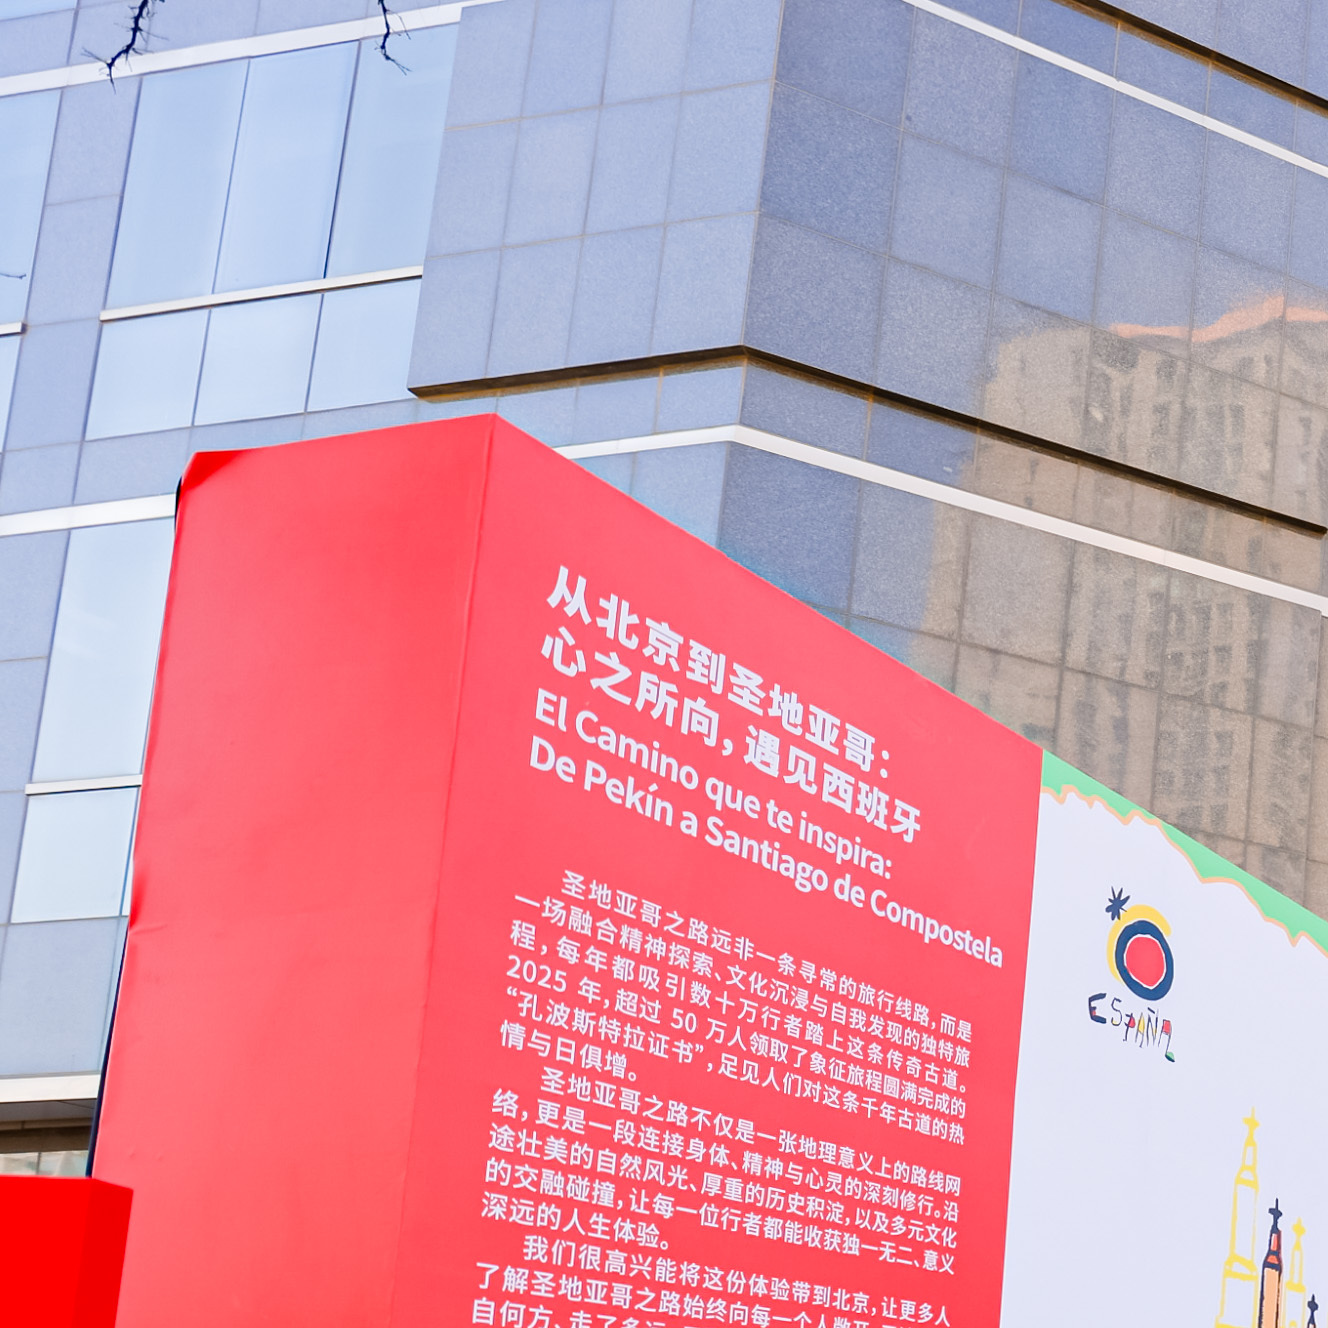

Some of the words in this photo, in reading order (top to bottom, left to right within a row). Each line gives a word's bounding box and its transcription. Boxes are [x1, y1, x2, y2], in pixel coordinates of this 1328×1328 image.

[541, 625, 921, 843] 心之所向，遇见西班牙
[546, 565, 890, 779] 从北京到圣地亚哥：
[529, 735, 576, 783] De
[583, 759, 674, 827] Pekín
[679, 810, 698, 838] a
[704, 815, 829, 893] Santiago
[833, 873, 866, 908] de
[870, 889, 1003, 968] Compostela
[535, 687, 568, 732] El
[575, 710, 699, 790] Camino
[705, 776, 761, 819] que
[766, 799, 794, 834] te
[798, 810, 892, 880] inspira:
[506, 954, 567, 993] 2025
[577, 976, 662, 1024] 年，超过
[670, 1007, 697, 1034] 50
